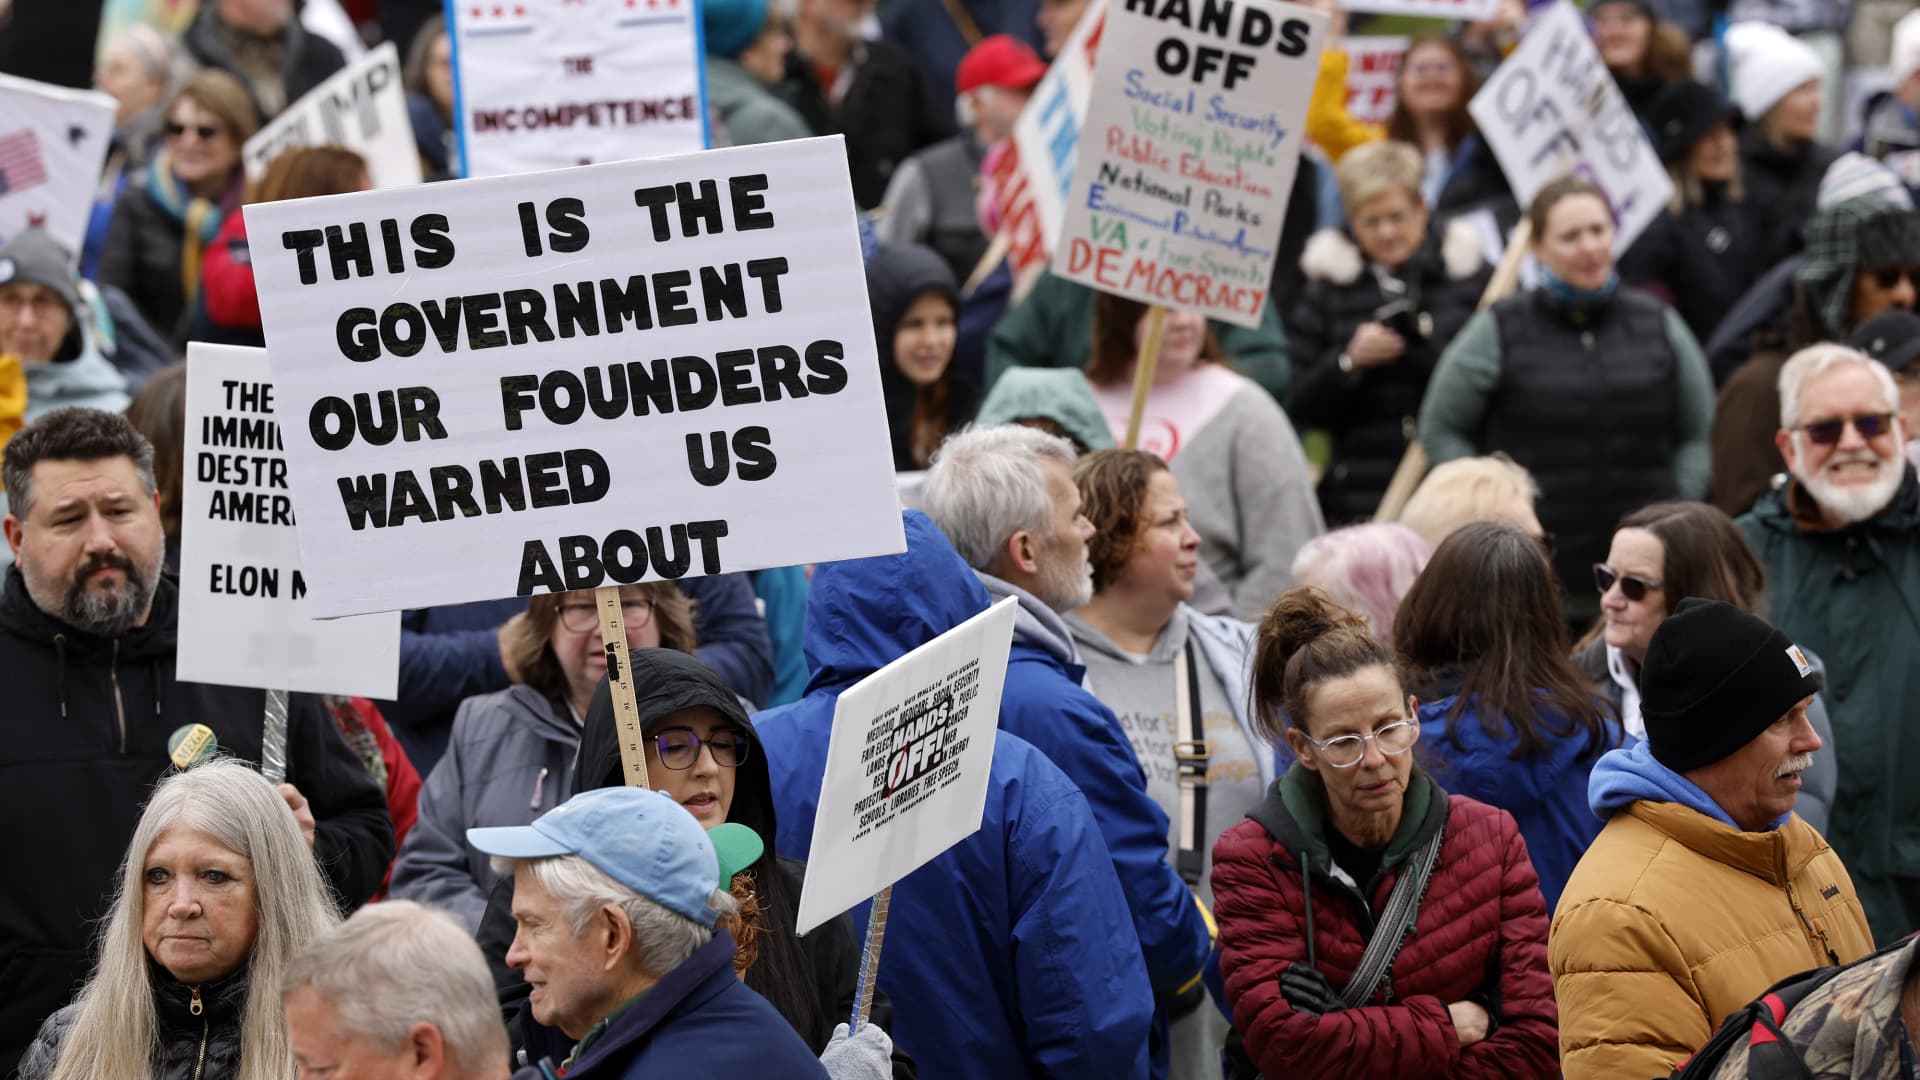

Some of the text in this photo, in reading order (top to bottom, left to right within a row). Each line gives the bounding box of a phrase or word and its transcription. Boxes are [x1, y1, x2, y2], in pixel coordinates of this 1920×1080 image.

[562, 55, 594, 77] THE
[1155, 38, 1256, 90] OFF
[473, 95, 696, 133] INCOMPETENCE
[1124, 69, 1195, 115] Social
[1205, 95, 1287, 150] Security
[1131, 105, 1204, 160] Voting
[1106, 125, 1172, 171] Public
[1099, 162, 1262, 228] National Parks
[282, 173, 775, 285] THIS IS THE
[1091, 215, 1127, 251] VA
[1068, 237, 1268, 316] DEMOCRACY
[336, 256, 789, 362] GOVERNMENT
[308, 339, 849, 451] OUR FOUNDERS
[202, 415, 285, 451] IMMI
[197, 451, 289, 490] DESTR
[336, 425, 777, 531] WARNED US
[208, 489, 297, 527] AMER
[210, 564, 278, 599] ELON
[516, 519, 729, 596] ABOUT
[860, 744, 875, 764] FAIR
[958, 682, 979, 706] PUBLIC
[865, 715, 895, 744] MEDICAID
[897, 696, 929, 726] MEDICARE
[952, 666, 980, 694] SECURITY
[891, 700, 949, 750] HANDS
[1134, 711, 1161, 731] for
[887, 730, 947, 792] OFF!
[942, 727, 958, 747] MER
[947, 735, 970, 760] ENERGY
[865, 753, 886, 777] LANDS
[858, 800, 887, 830] SCHOOLS
[889, 781, 920, 811] LIBRARIES
[922, 770, 938, 791] FREE
[936, 756, 960, 782] SPEECH
